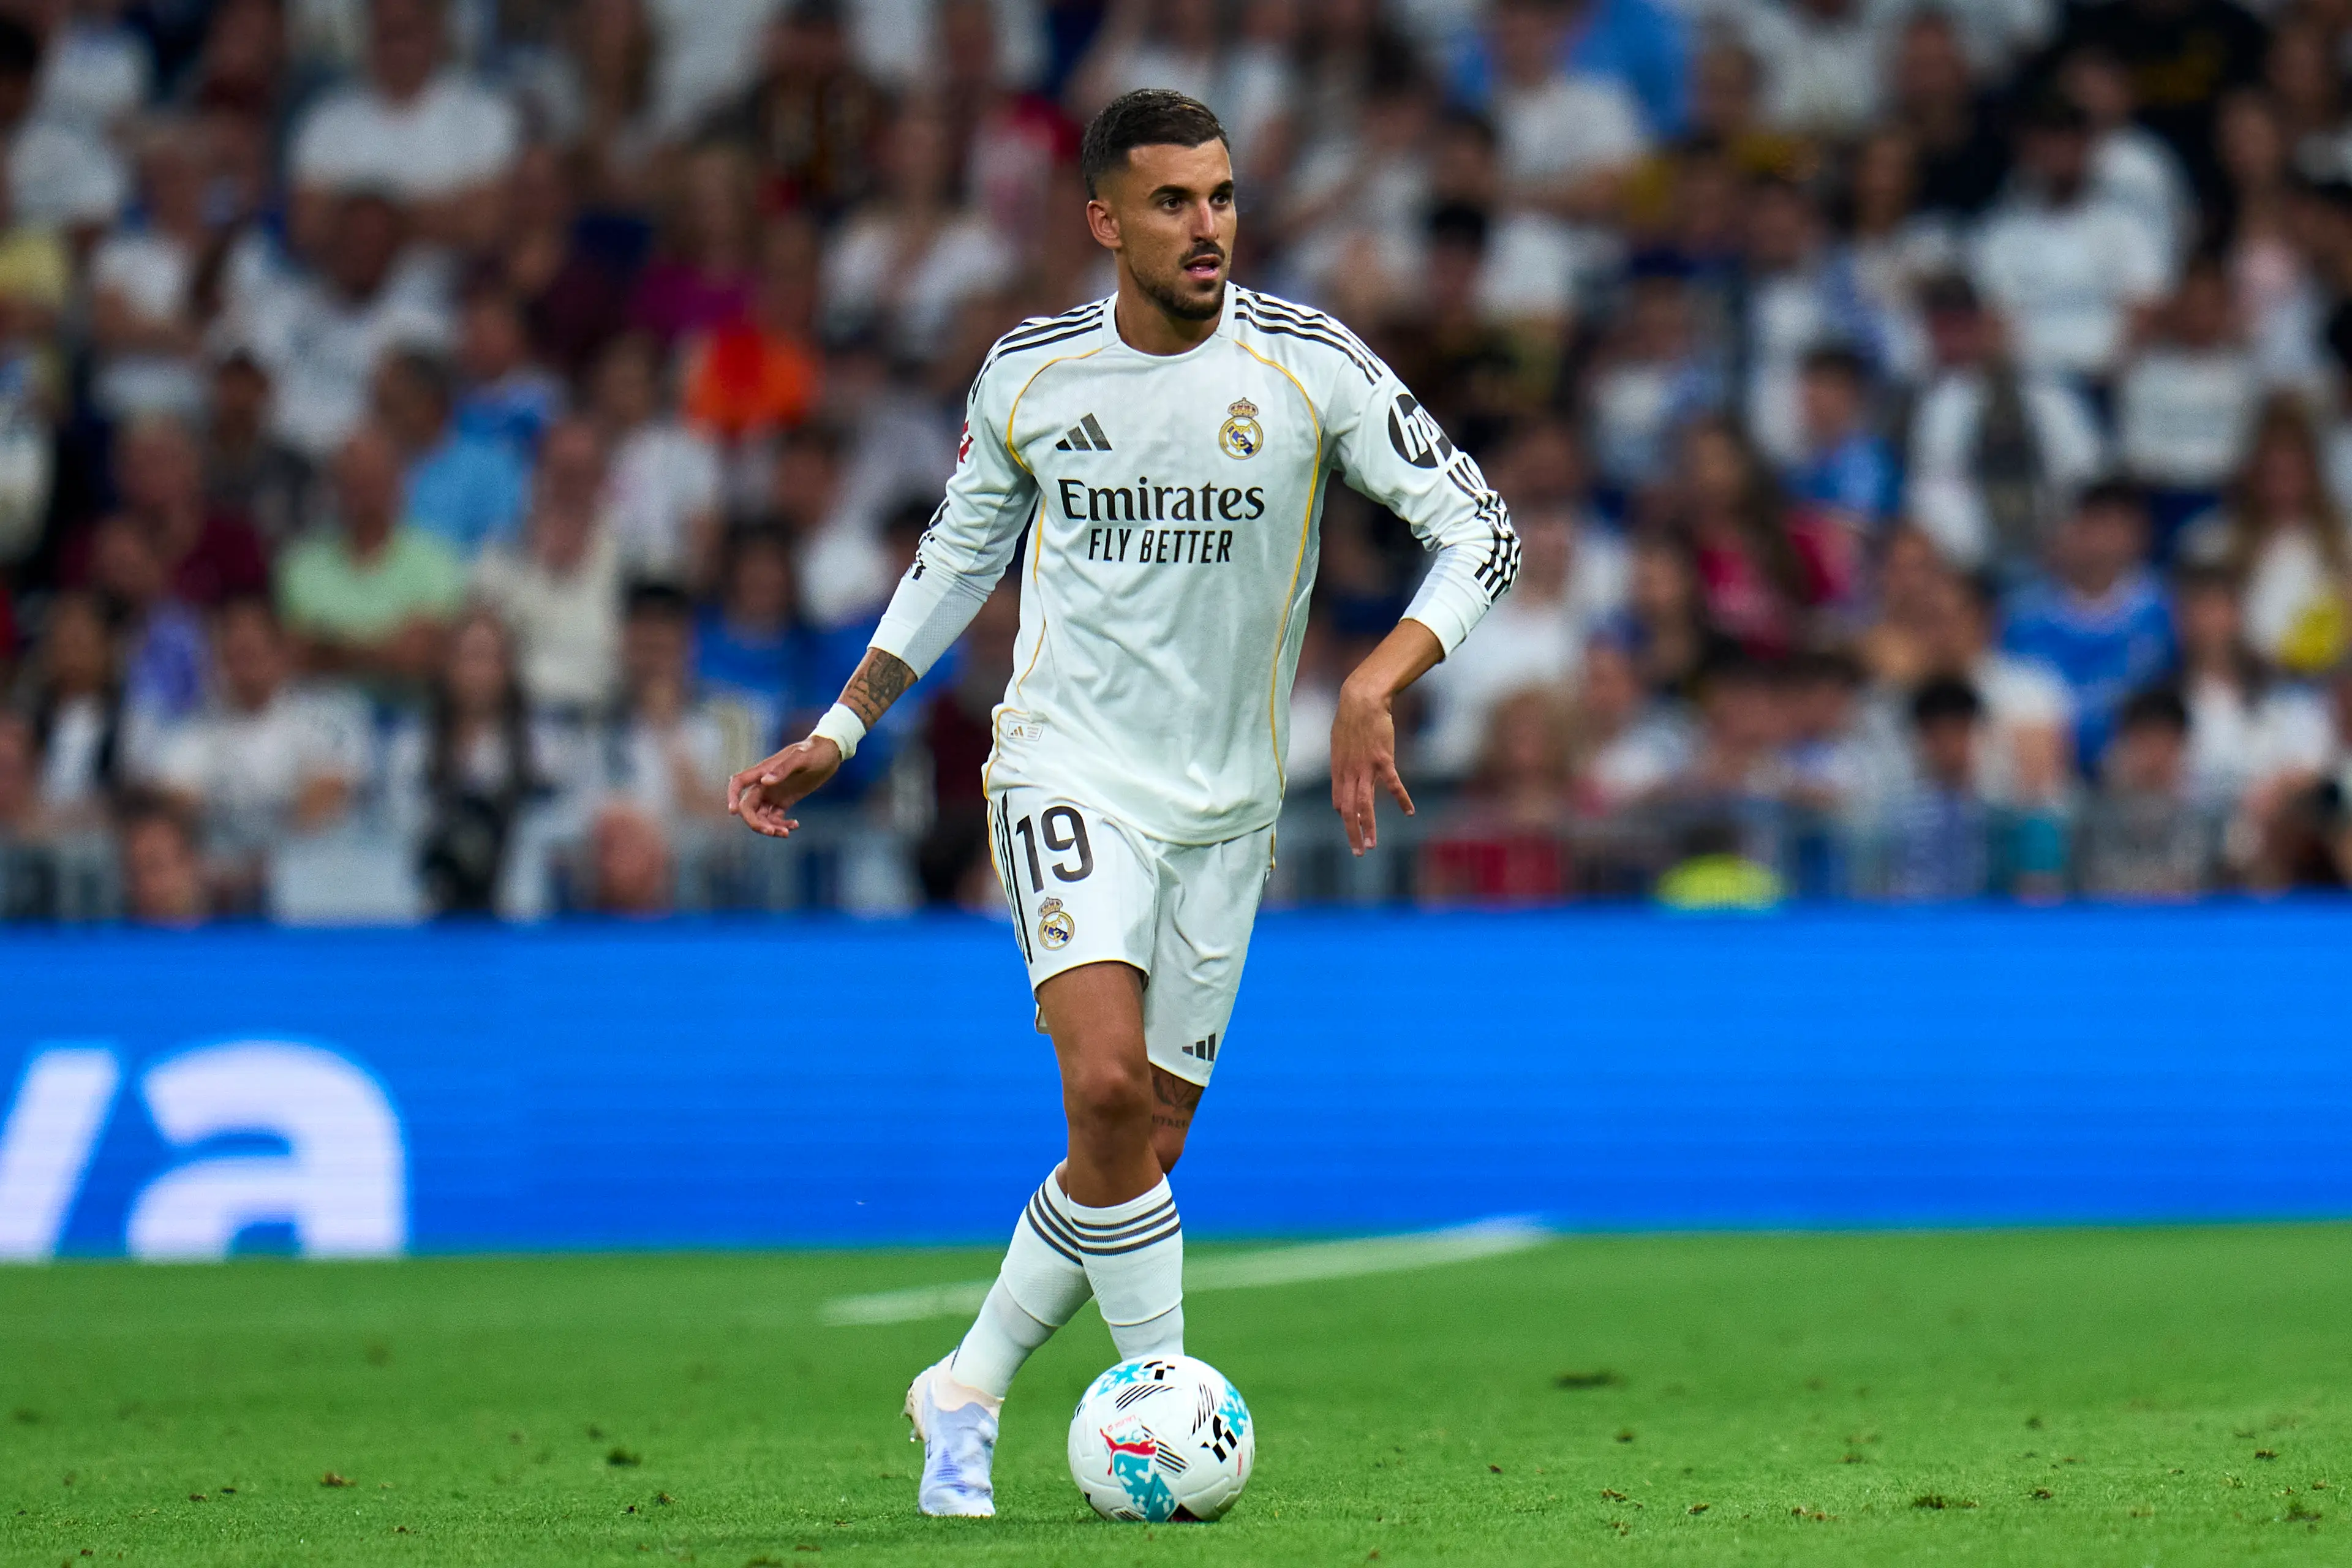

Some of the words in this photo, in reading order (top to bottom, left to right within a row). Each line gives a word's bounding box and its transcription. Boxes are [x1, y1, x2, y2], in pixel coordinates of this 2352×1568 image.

[1390, 395, 1447, 467] hp
[1057, 476, 1265, 522] Emirates
[1088, 527, 1132, 562] FLY
[1139, 529, 1233, 564] BETTER
[1016, 805, 1093, 894] 19
